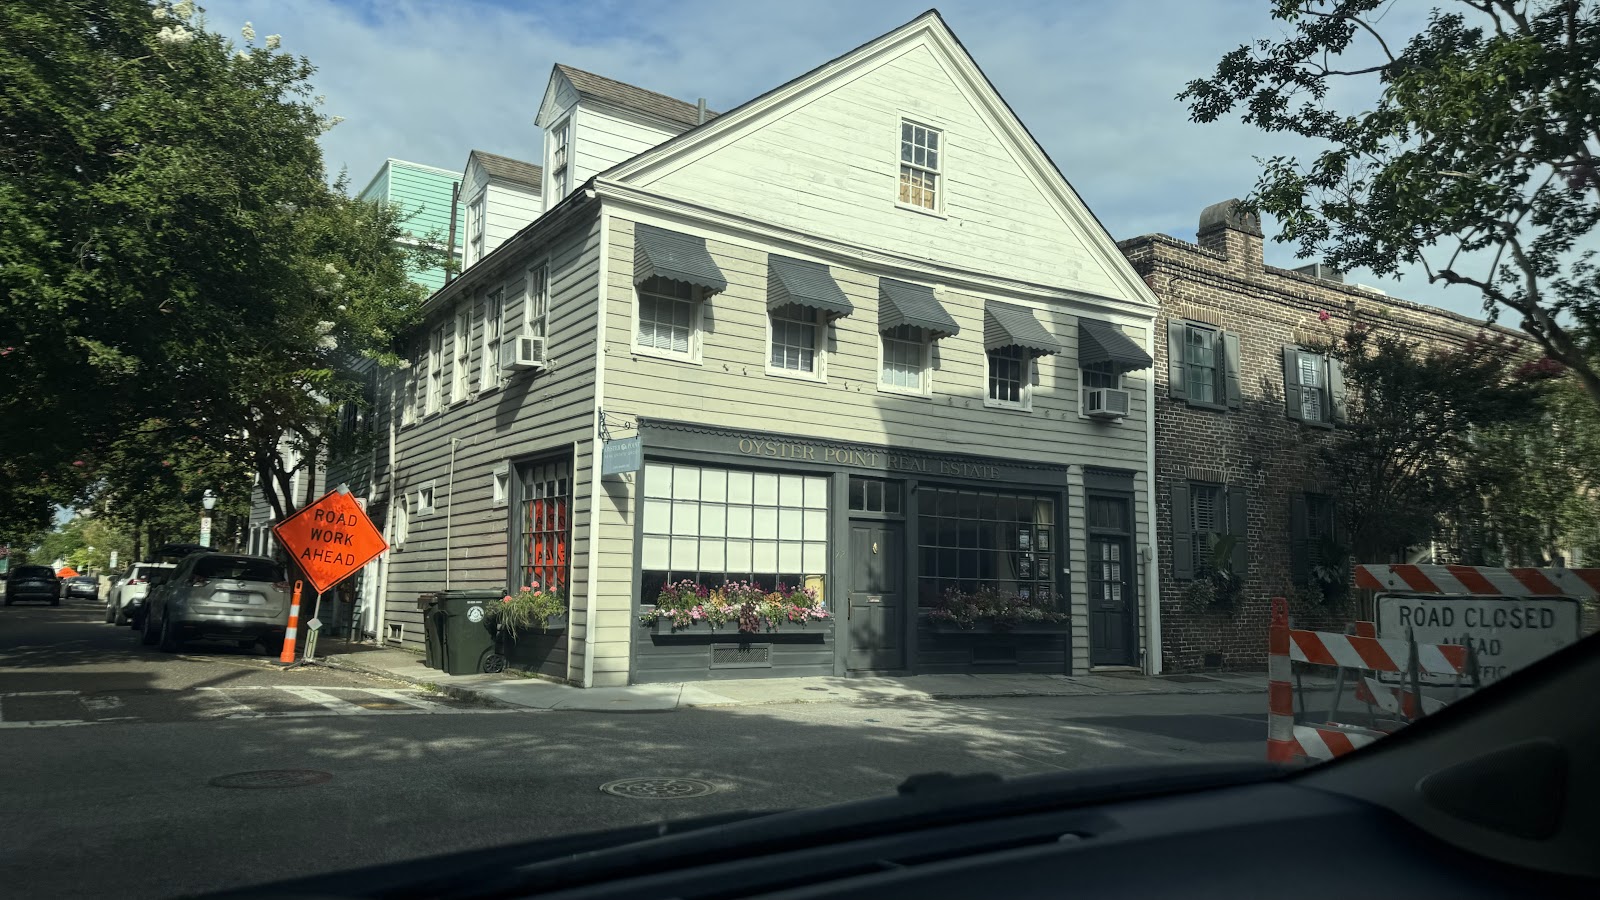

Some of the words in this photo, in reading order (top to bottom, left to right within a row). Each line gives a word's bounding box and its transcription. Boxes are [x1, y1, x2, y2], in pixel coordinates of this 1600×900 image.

[739, 439, 814, 460] OYSTER
[824, 448, 879, 467] POINT
[886, 455, 932, 472] REAL
[940, 461, 1000, 479] ESTATE
[314, 508, 358, 527] ROAD
[310, 528, 354, 547] WORK
[300, 547, 355, 566] AHEAD
[1399, 605, 1455, 627] ROAD
[1464, 606, 1554, 630] CLOSED
